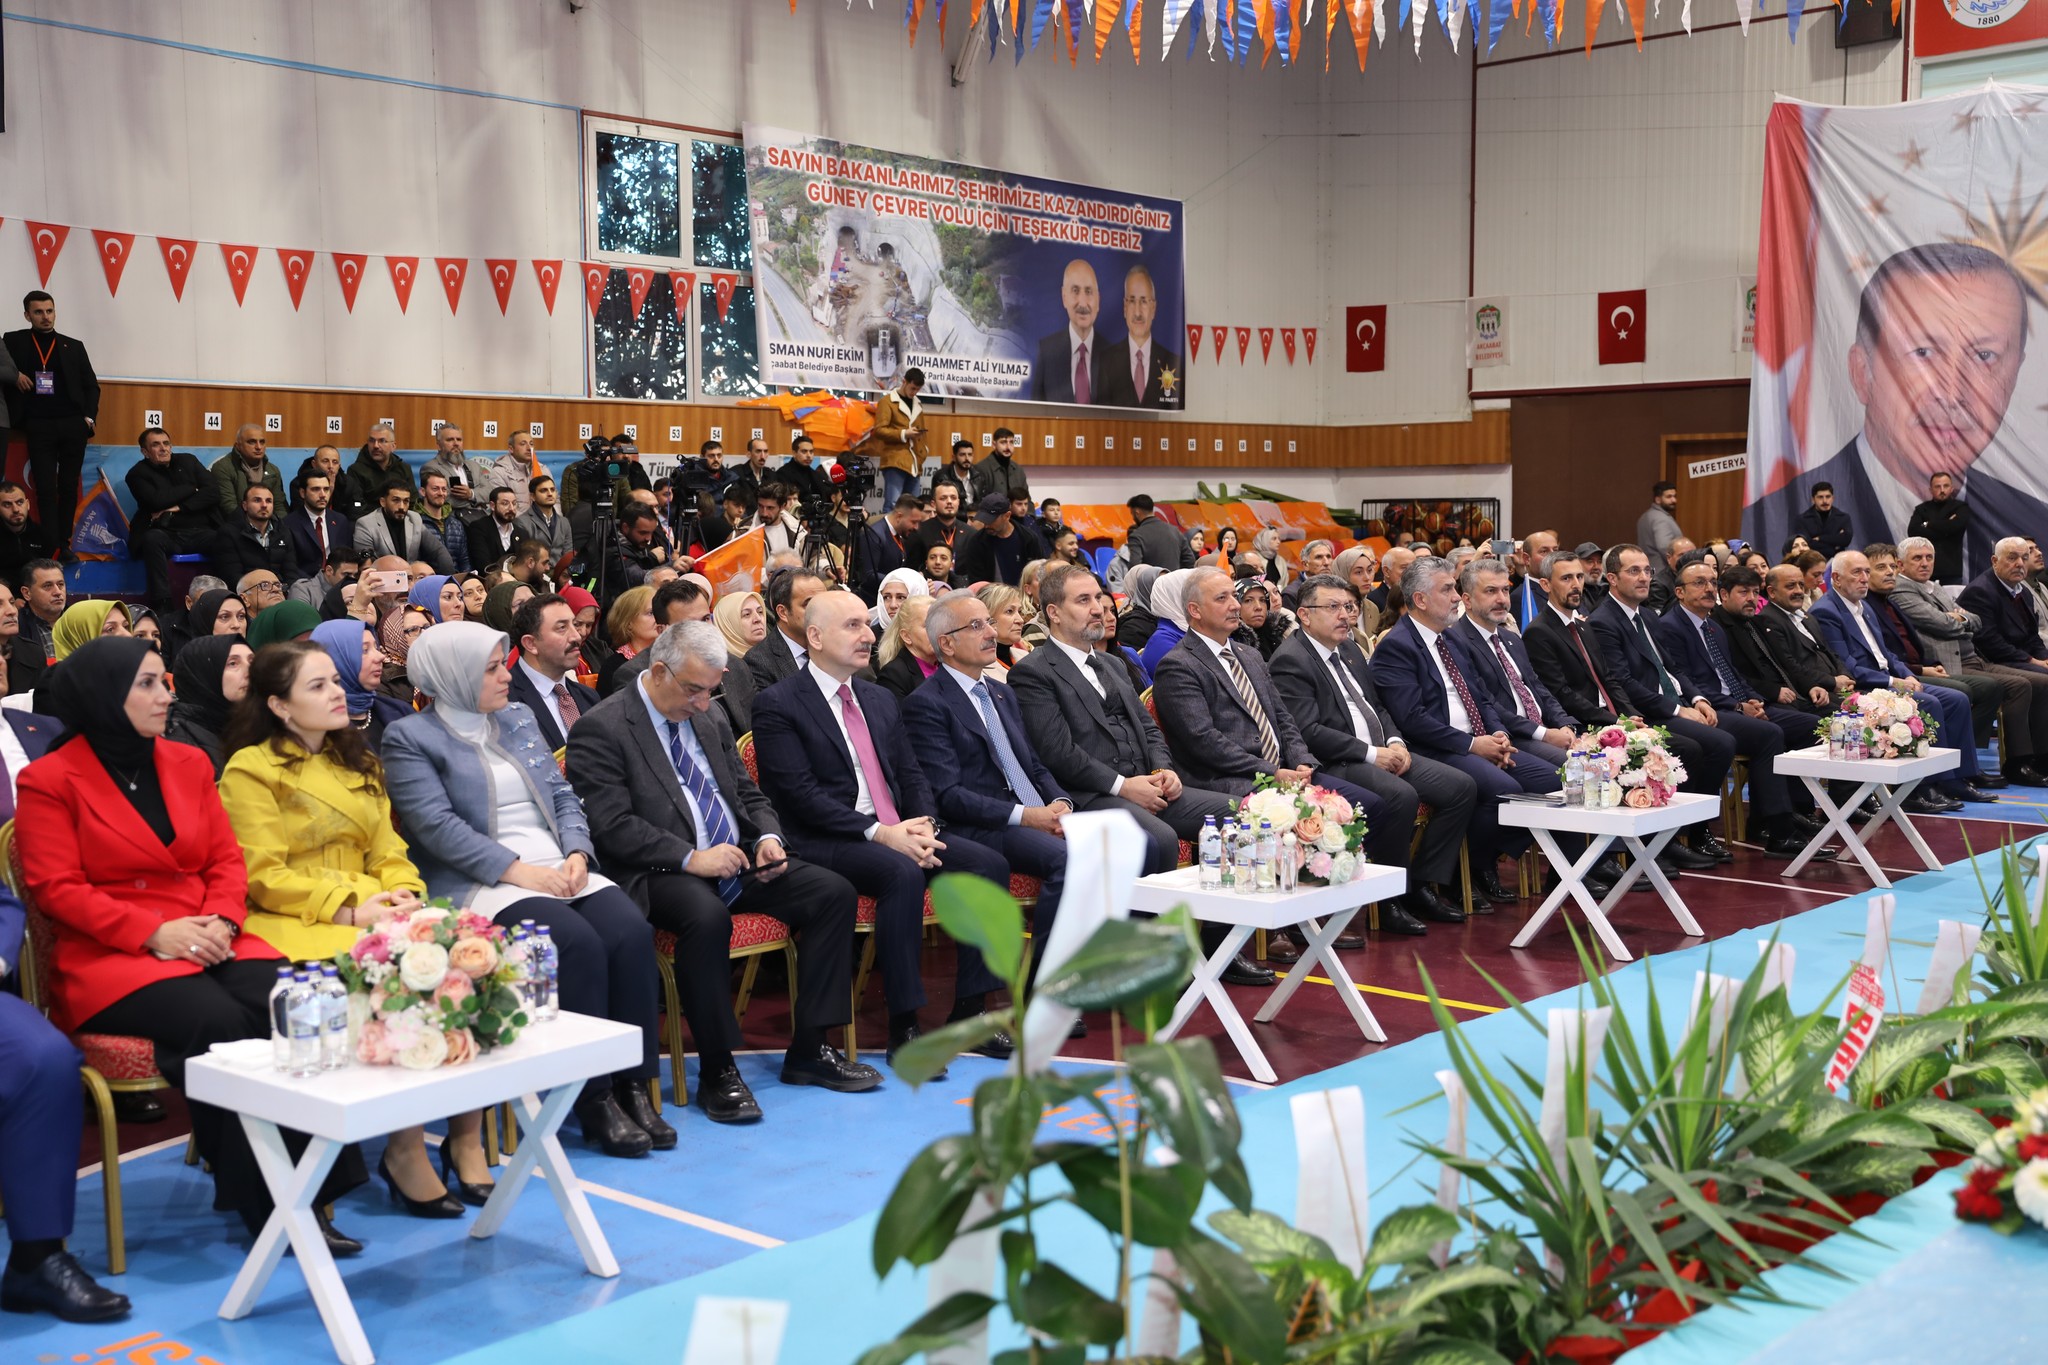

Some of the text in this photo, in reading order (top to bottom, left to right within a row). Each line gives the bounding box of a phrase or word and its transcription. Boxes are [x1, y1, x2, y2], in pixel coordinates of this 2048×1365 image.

[1978, 15, 2000, 25] 1880
[767, 147, 1170, 229] SAYIN BAKANLARIMIZ ŞEHRİMİZE KAZANDIRDIĞINIZ
[807, 180, 1141, 250] GÜNEY ÇEVRE YOLU İÇİN TEŞEKKÜR EDERİZ
[807, 345, 835, 360] NURİ
[837, 347, 864, 362] EKİM
[798, 362, 833, 374] Belediye
[834, 364, 865, 375] Başkanı
[906, 355, 1029, 376] MUHAMMET ALİ YILMAZ
[928, 371, 945, 381] Parti
[946, 373, 979, 383] Akçaabat
[994, 376, 1019, 387] Başkanı
[148, 414, 160, 425] 43
[208, 416, 219, 427] 44
[268, 418, 279, 429] 45
[329, 420, 340, 431] 46
[485, 425, 495, 434] 49
[532, 426, 541, 436] 50
[581, 427, 590, 437] 51
[626, 428, 635, 437] 52
[671, 429, 680, 439] 53
[712, 430, 720, 439] 54
[754, 431, 761, 440] 55
[984, 436, 991, 444] 59
[1014, 437, 1020, 445] 60
[1046, 437, 1052, 446] 61
[1077, 438, 1083, 446] 62
[1134, 439, 1140, 448] 64
[1162, 440, 1168, 448] 65
[1216, 441, 1221, 449] 67
[1692, 457, 1746, 475] KAFETERYA
[86, 510, 97, 521] AK
